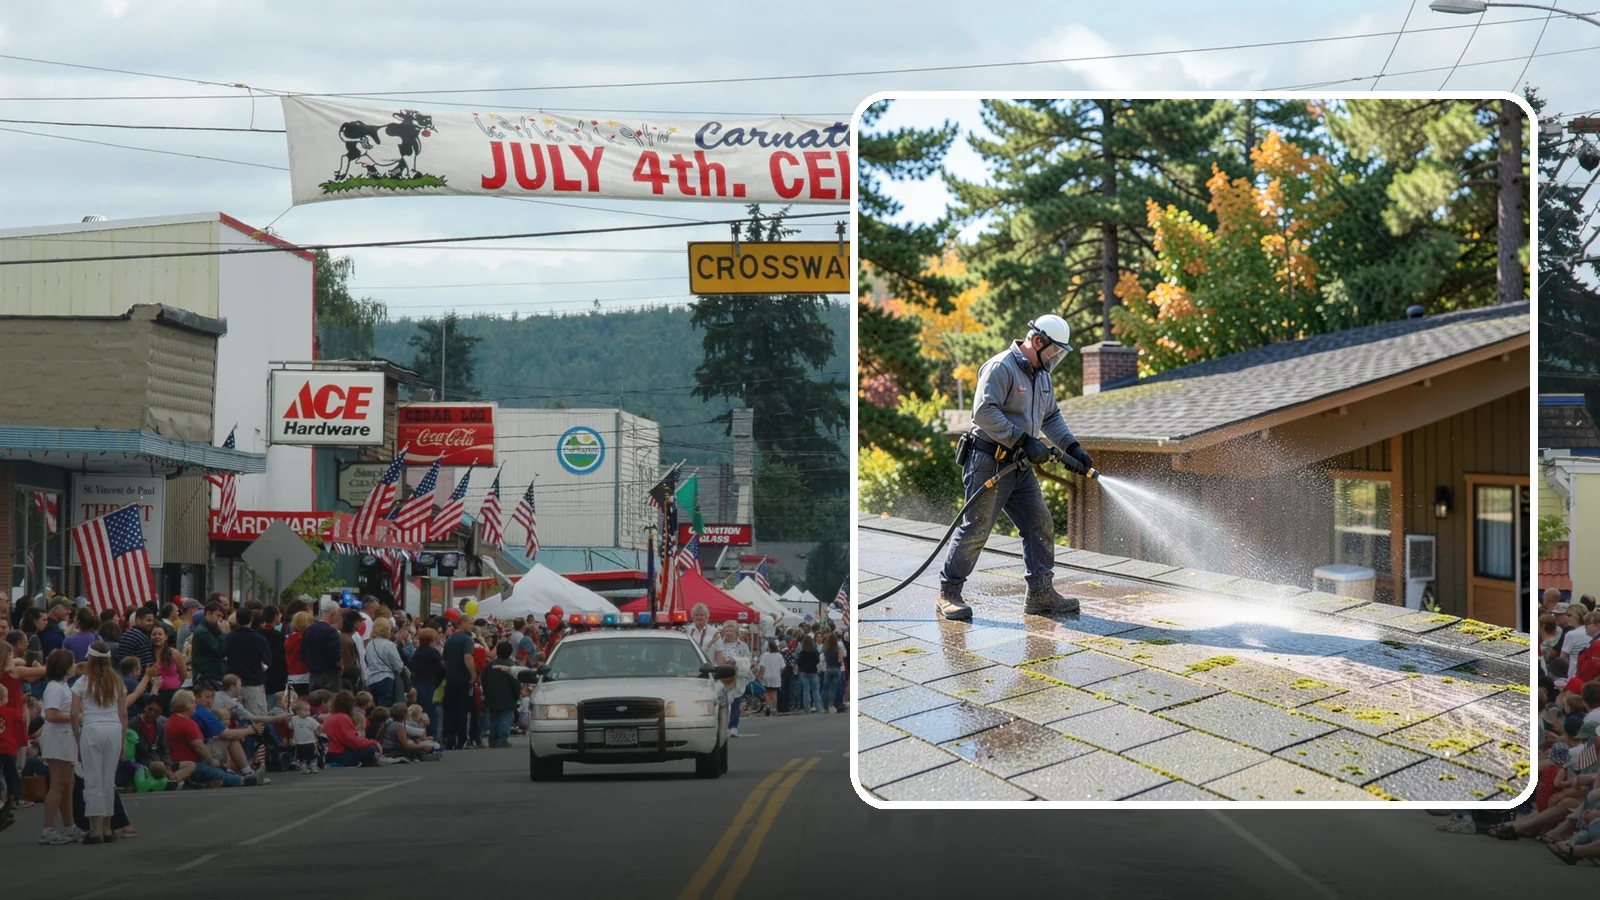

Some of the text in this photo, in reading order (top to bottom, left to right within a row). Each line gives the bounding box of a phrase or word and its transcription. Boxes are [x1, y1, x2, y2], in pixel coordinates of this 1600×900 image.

[694, 121, 850, 149] Carnat
[481, 140, 605, 194] JULY
[632, 149, 746, 197] 4th.
[696, 254, 850, 280] CROSSWA
[282, 380, 373, 420] ACE
[406, 409, 485, 422] CEDAR LOG
[283, 421, 371, 436] Hardware
[416, 427, 477, 447] Coca-Cola
[354, 466, 384, 480] Simpl
[95, 485, 124, 494] Vincent
[126, 486, 136, 494] de
[137, 486, 155, 495] Paul
[212, 515, 331, 536] HARDARE
[688, 526, 741, 535] CRNATION
[699, 535, 730, 543] GLASS
